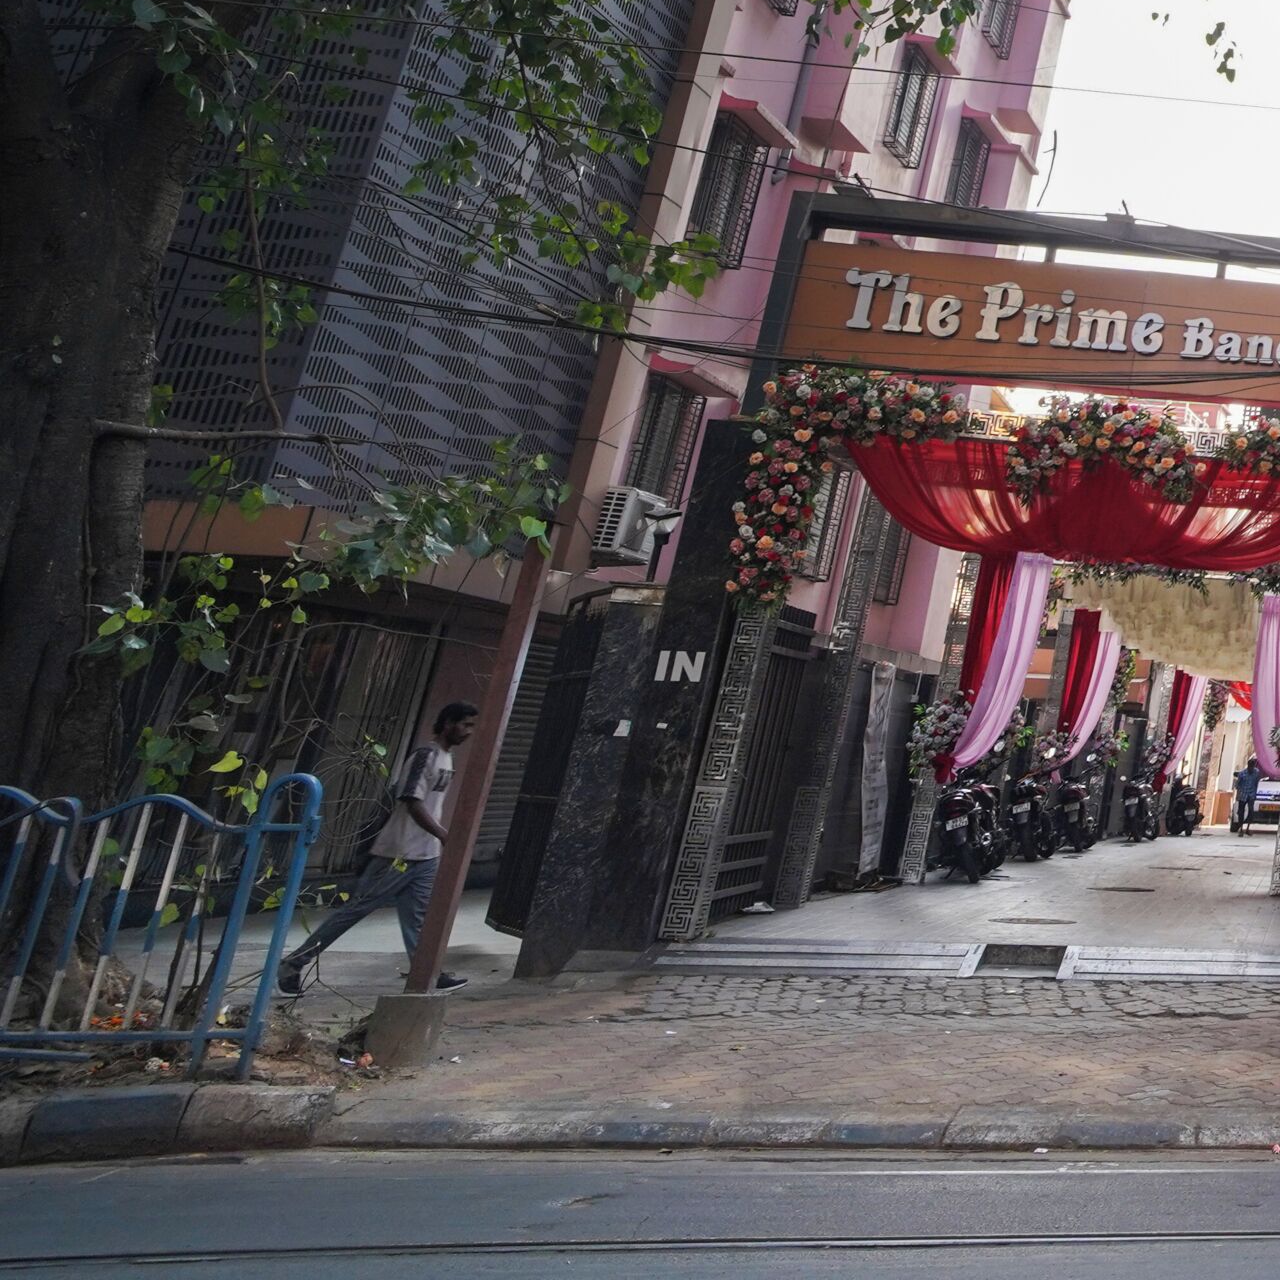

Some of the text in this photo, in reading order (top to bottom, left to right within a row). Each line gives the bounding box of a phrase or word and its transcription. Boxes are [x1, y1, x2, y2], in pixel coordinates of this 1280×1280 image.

[845, 267, 964, 338] The
[975, 281, 1165, 355] Prime
[654, 650, 707, 683] IN
